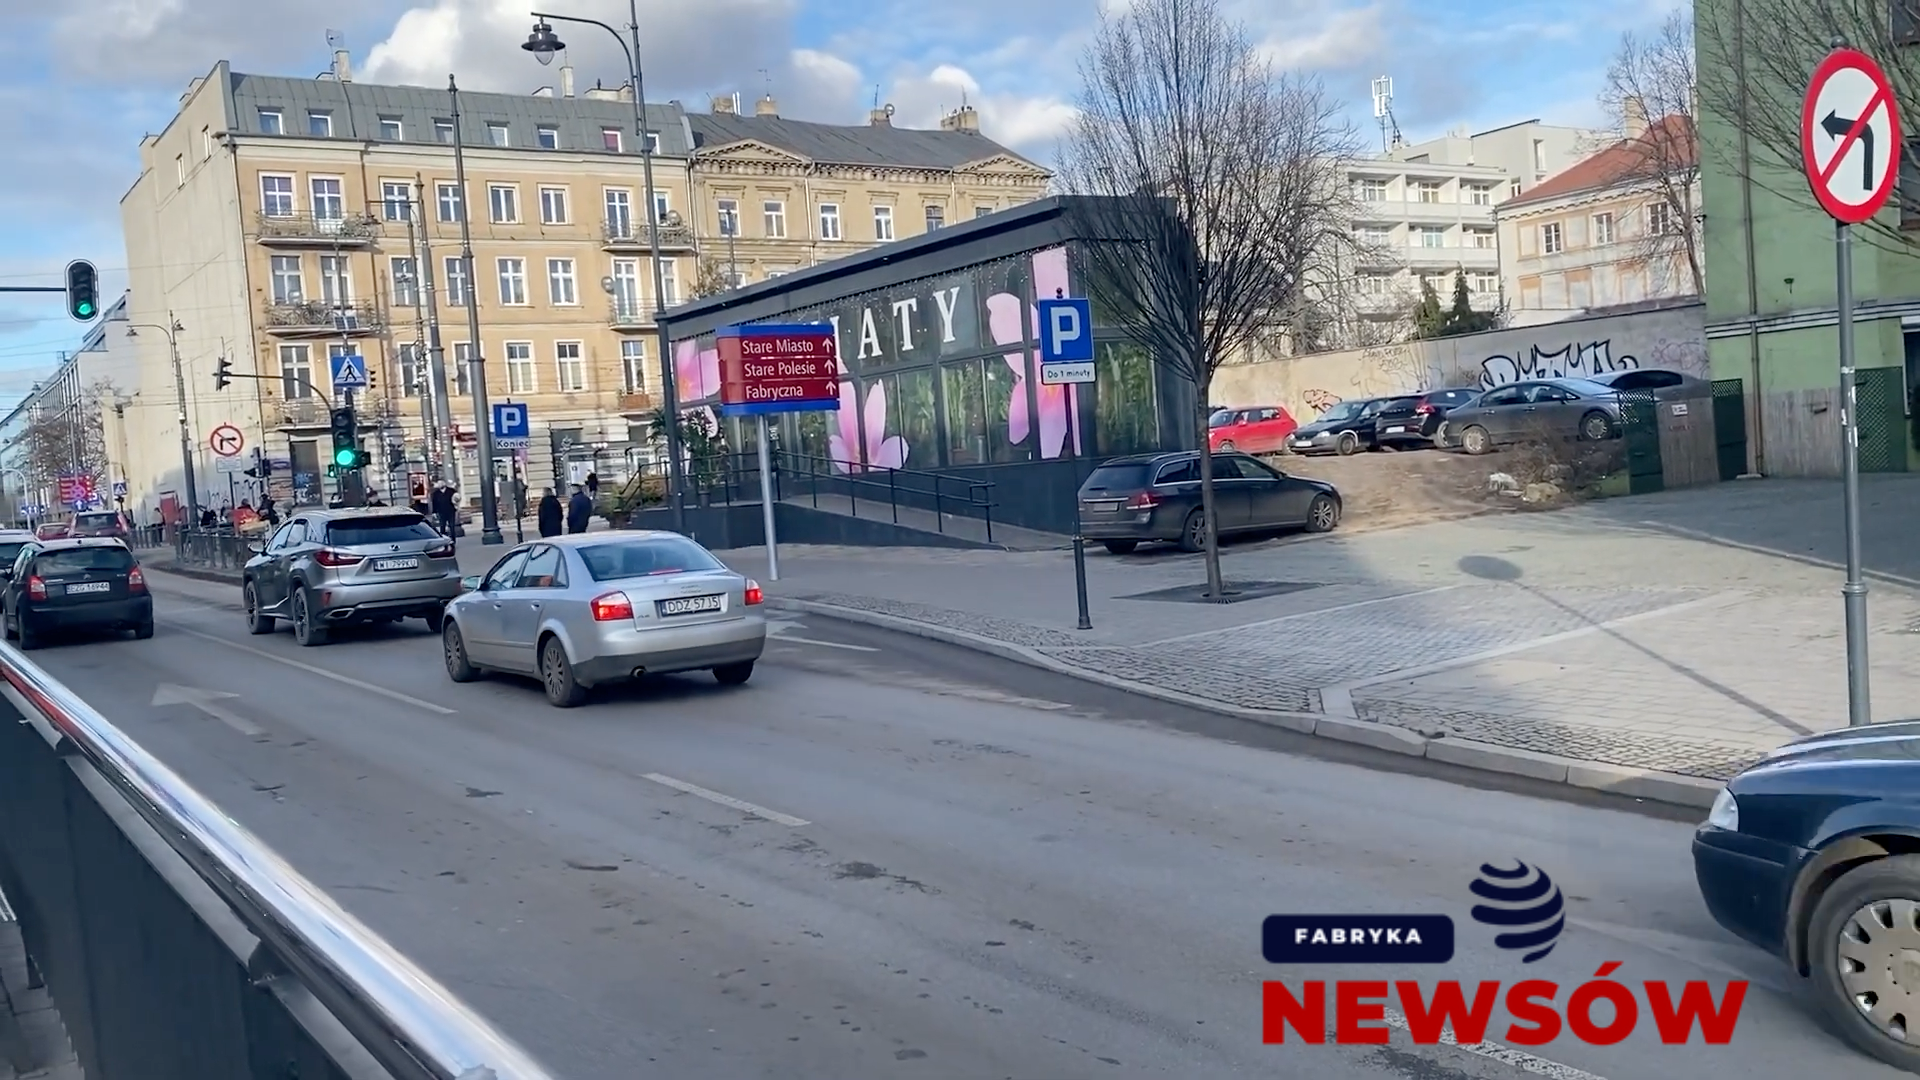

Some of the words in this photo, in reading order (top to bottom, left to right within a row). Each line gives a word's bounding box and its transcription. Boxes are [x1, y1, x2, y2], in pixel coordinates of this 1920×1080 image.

[812, 286, 960, 362] IATY
[1050, 306, 1081, 355] P
[742, 340, 773, 355] Stare
[776, 338, 814, 354] Miasto
[744, 363, 774, 377] Stare
[778, 360, 816, 375] Polesie
[1066, 369, 1090, 377] minuty
[745, 383, 804, 401] Fabryczna
[501, 407, 521, 434] P
[497, 440, 529, 448] Koniec
[667, 600, 691, 612] DDZ
